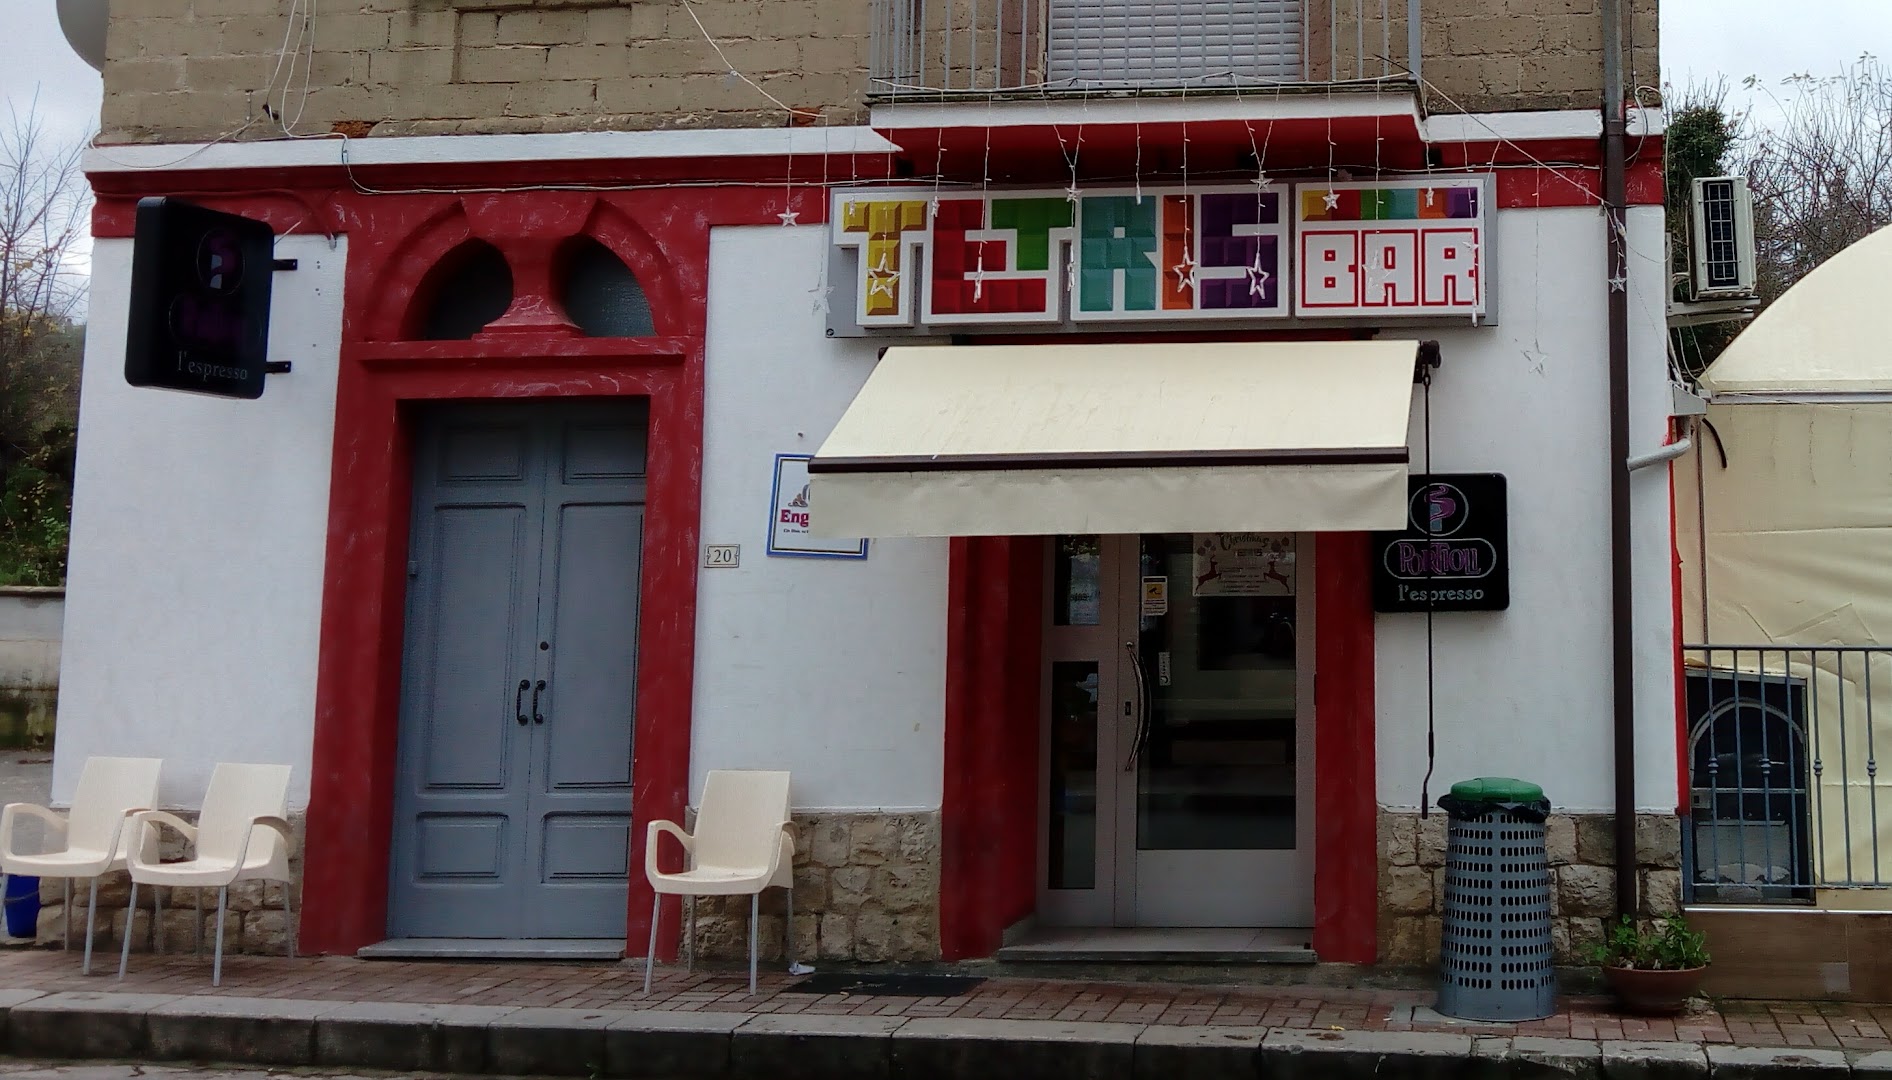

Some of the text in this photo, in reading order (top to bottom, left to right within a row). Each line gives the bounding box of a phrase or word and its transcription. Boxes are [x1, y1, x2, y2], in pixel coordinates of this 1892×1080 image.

[839, 188, 1479, 322] TETRIS BAR
[177, 350, 249, 382] l'espresso
[779, 509, 810, 527] Eng
[713, 549, 732, 563] 20
[1397, 584, 1485, 607] l'espresso
